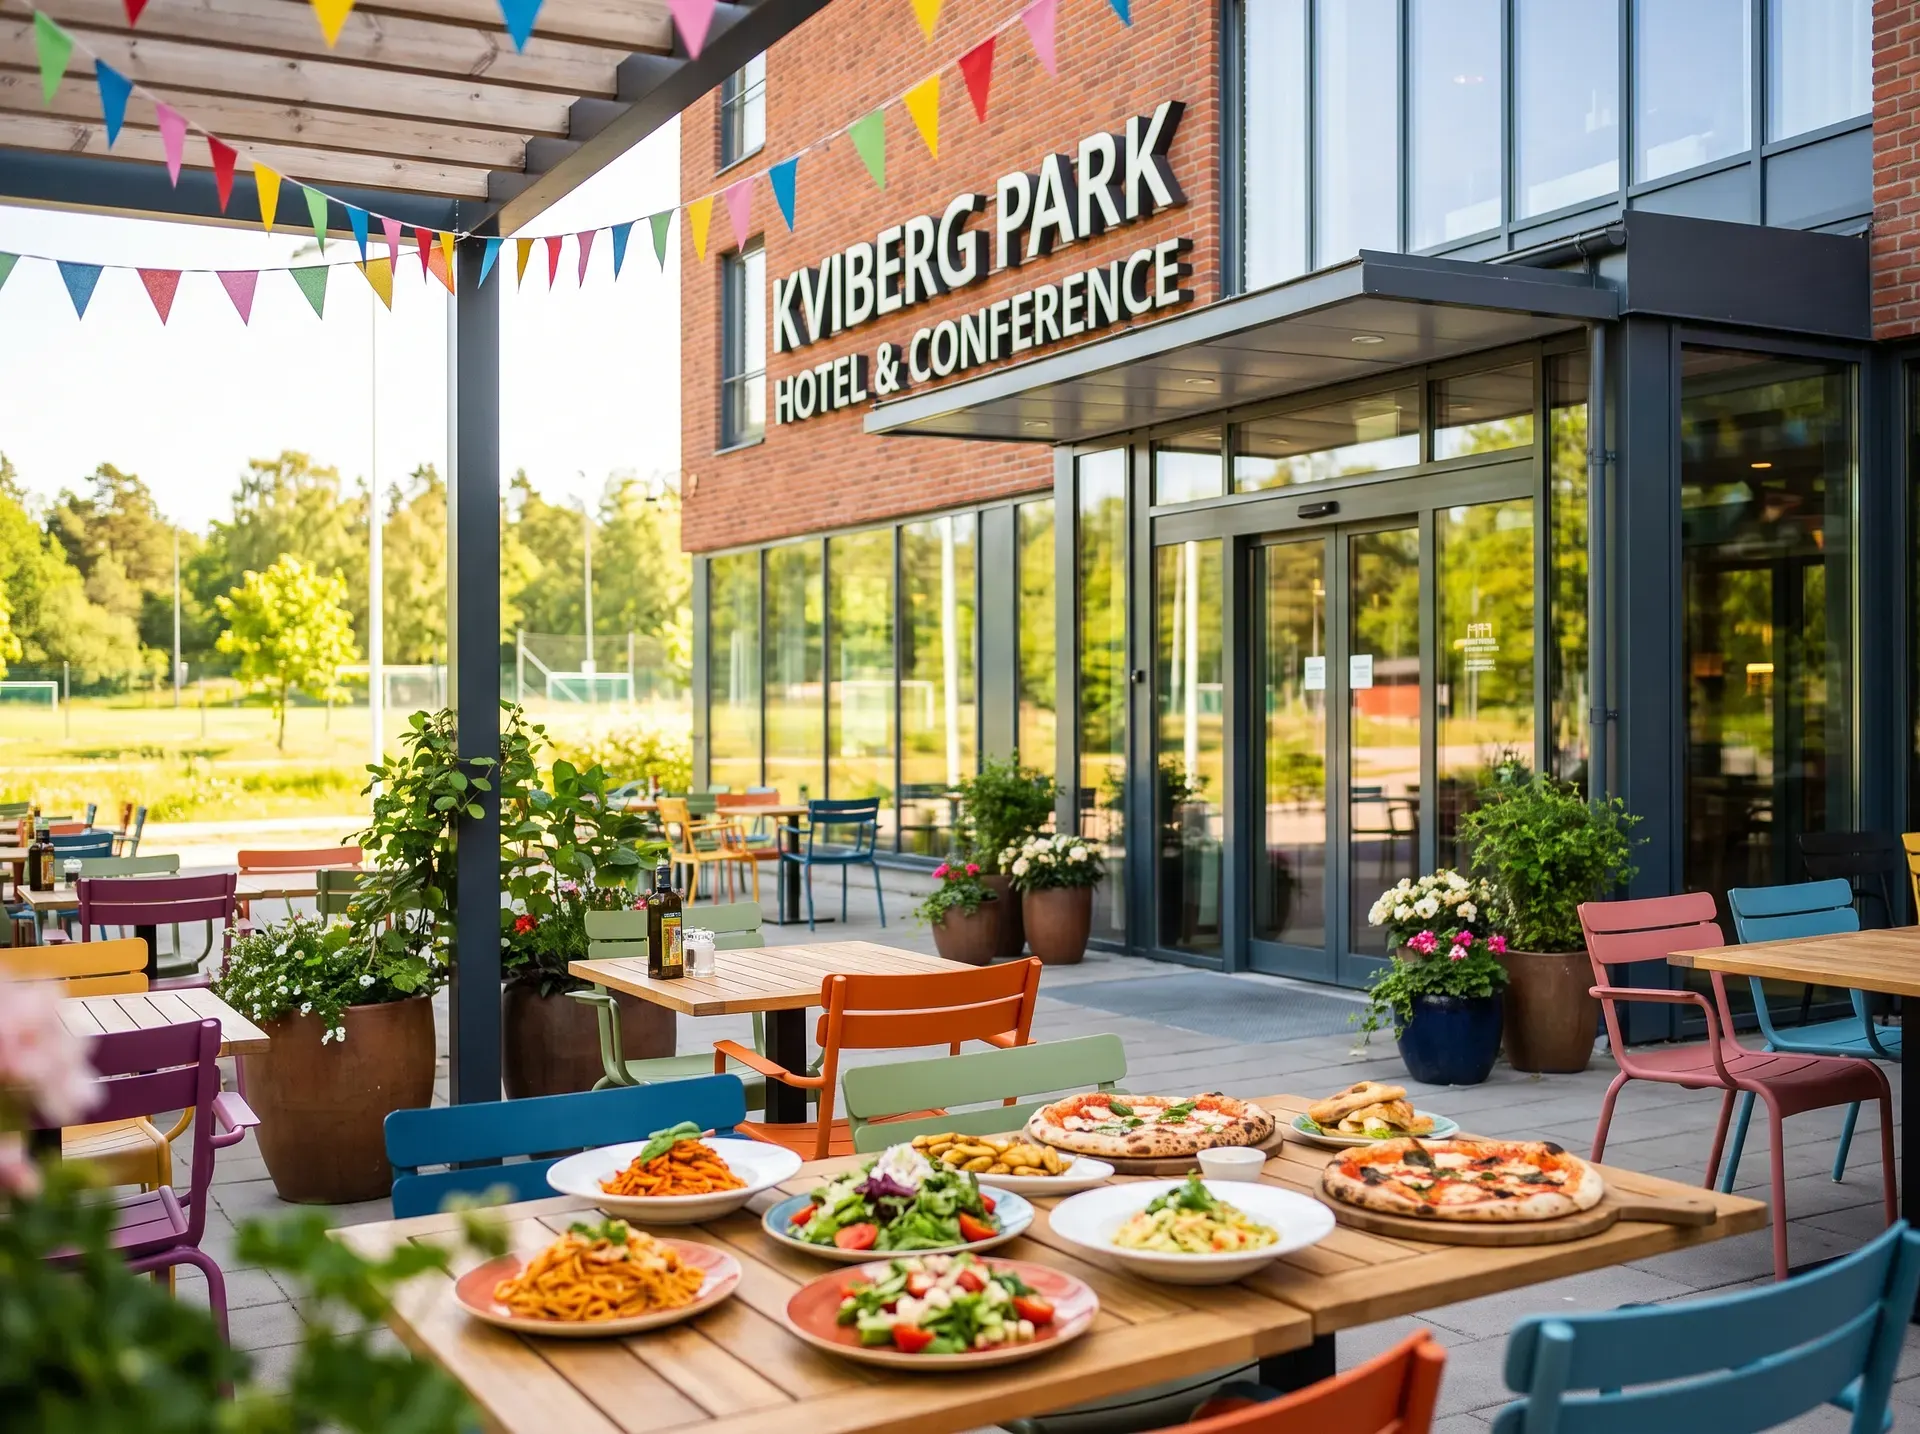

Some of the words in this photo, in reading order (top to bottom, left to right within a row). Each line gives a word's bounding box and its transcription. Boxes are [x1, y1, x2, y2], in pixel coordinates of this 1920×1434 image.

[773, 194, 982, 353] KVIBERG
[997, 101, 1181, 269] PARK
[774, 353, 867, 425] HOTEL
[874, 342, 900, 395] &
[909, 237, 1183, 383] CONFERENCE
